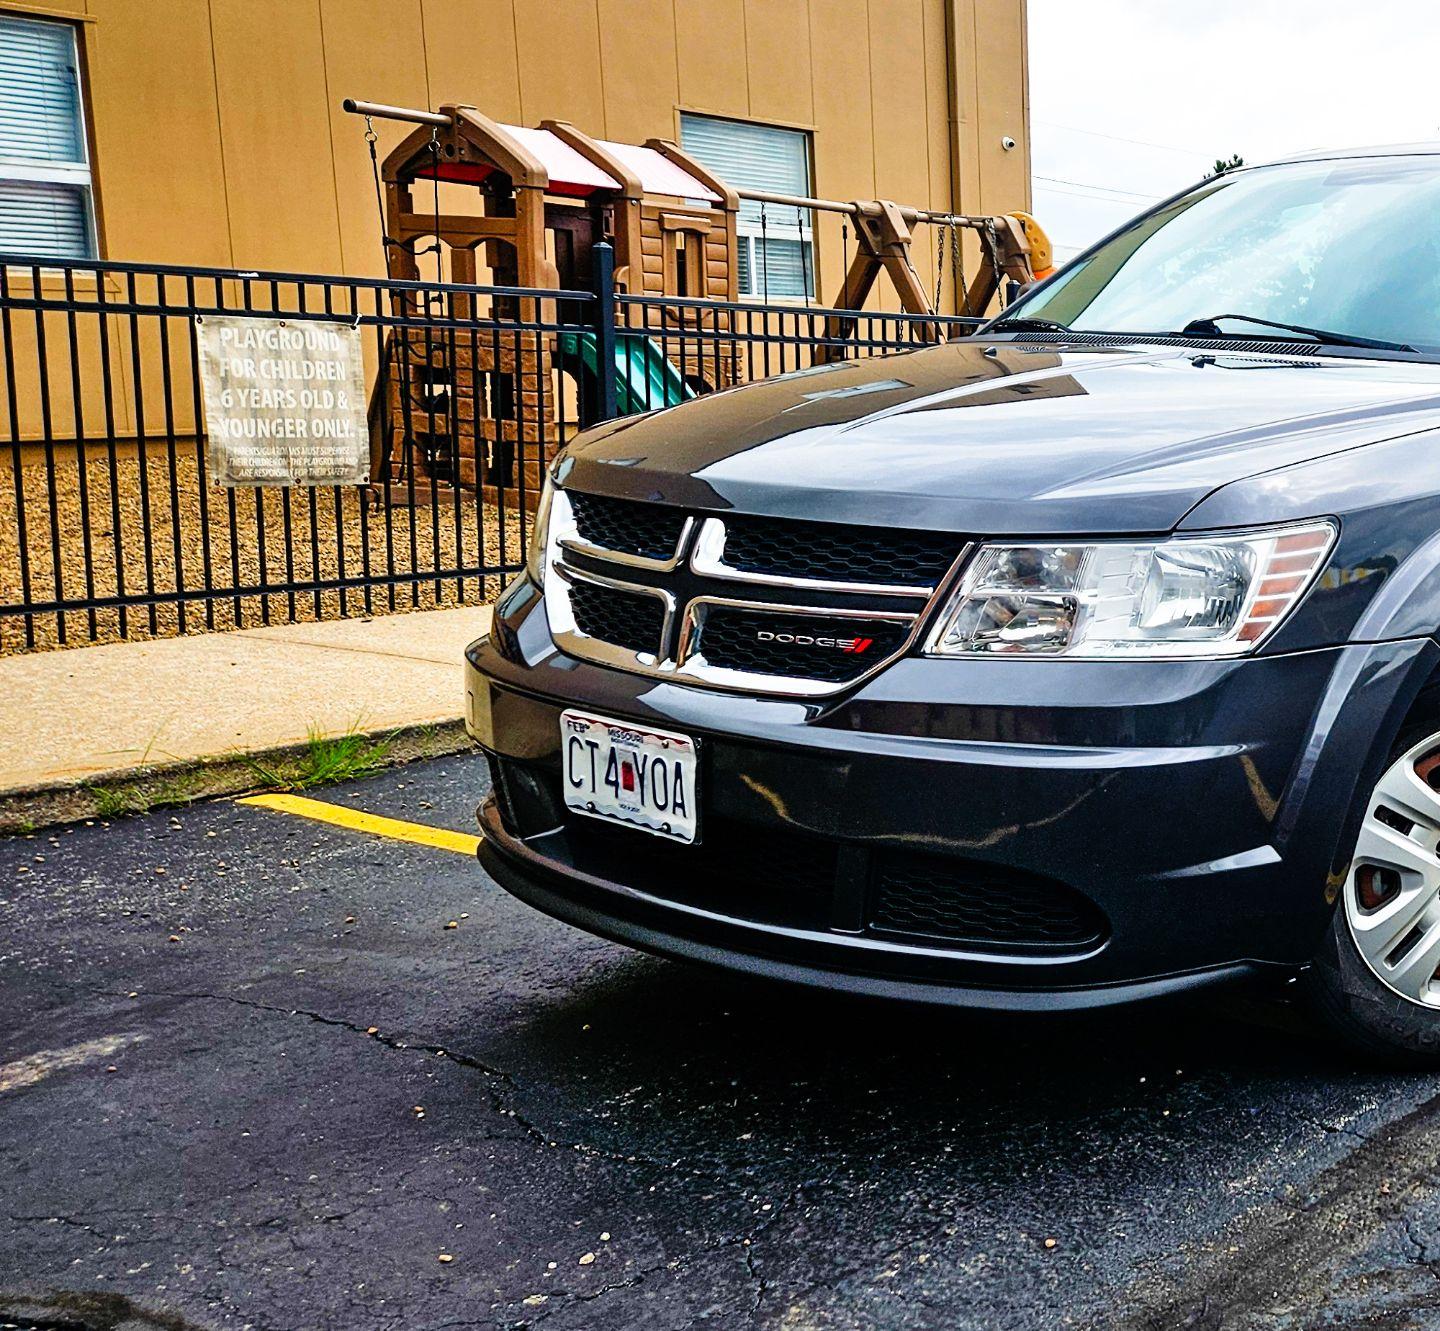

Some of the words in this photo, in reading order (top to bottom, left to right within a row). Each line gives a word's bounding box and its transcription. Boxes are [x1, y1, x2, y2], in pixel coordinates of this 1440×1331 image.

[220, 328, 340, 350] PLAYGROUND
[220, 358, 257, 378] FOR
[260, 359, 346, 380] CHILDREN
[222, 390, 234, 409] 6
[237, 389, 297, 409] YEARS
[300, 390, 334, 409] OLD
[337, 390, 349, 410] &
[220, 418, 308, 438] YOUNGER
[311, 418, 355, 438] ONLY.
[757, 631, 856, 649] DODGE
[608, 728, 644, 744] MISSOURI
[568, 735, 619, 799] CT4
